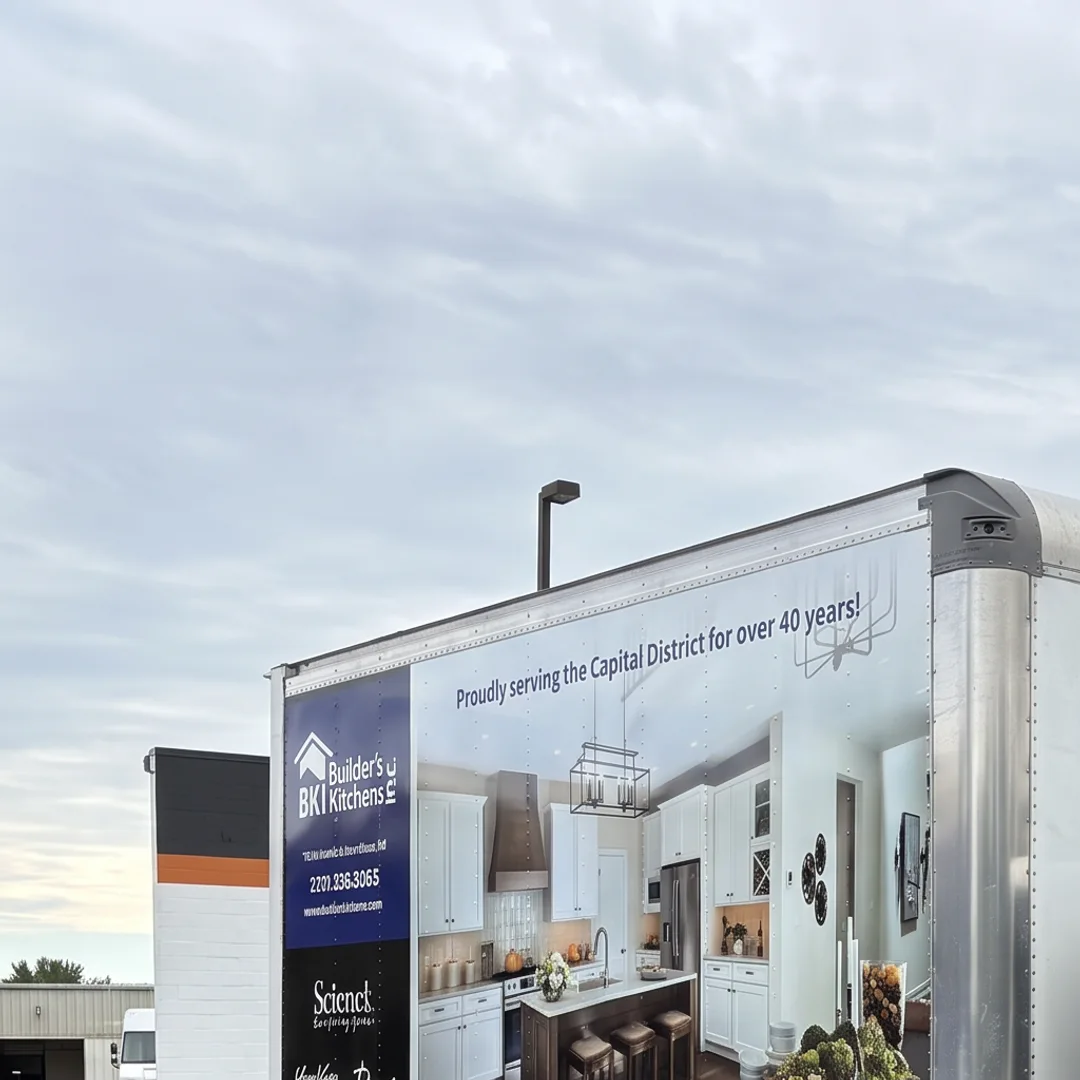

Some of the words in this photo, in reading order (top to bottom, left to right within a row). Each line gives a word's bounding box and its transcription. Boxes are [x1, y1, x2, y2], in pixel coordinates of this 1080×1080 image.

[457, 678, 507, 709] Proudly
[510, 668, 561, 697] serving
[564, 659, 588, 685] the
[590, 644, 644, 681] Capital
[647, 633, 706, 667] District
[708, 627, 734, 650] for
[736, 617, 776, 645] over
[779, 607, 801, 634] 40
[804, 591, 861, 636] years!
[329, 751, 384, 786] Builder's
[299, 783, 326, 819] BKI
[329, 783, 385, 814] Kitchens
